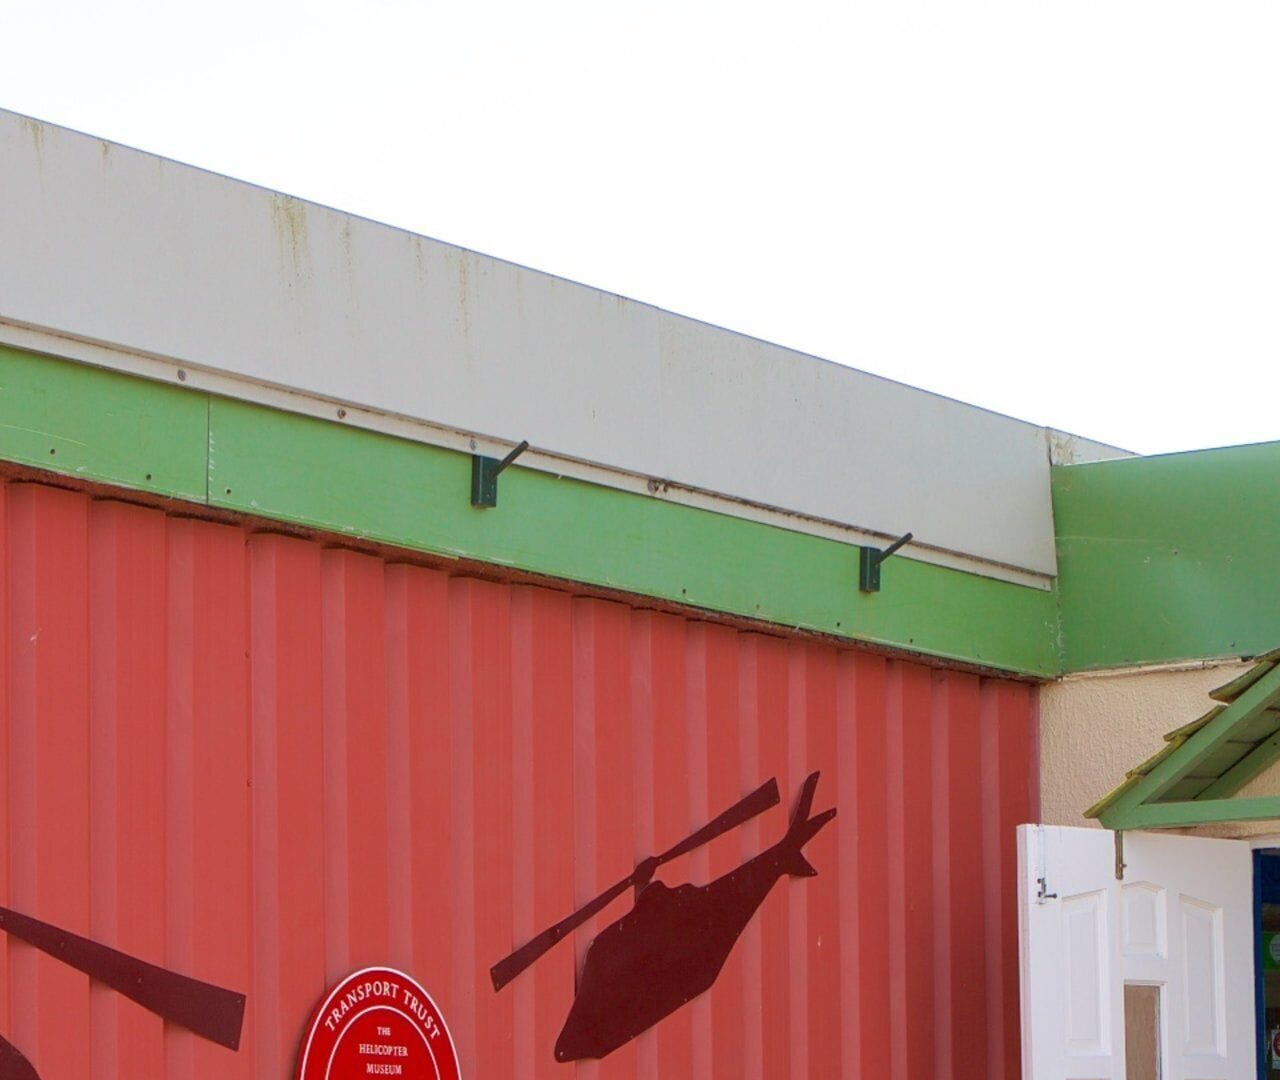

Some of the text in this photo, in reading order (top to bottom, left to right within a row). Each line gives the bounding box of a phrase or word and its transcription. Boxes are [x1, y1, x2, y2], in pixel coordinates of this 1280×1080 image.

[324, 980, 441, 1040] TRANSPORT TRUST
[376, 1026, 391, 1036] THE
[359, 1043, 409, 1057] HELICOPTER
[366, 1063, 402, 1075] MUSEUM
